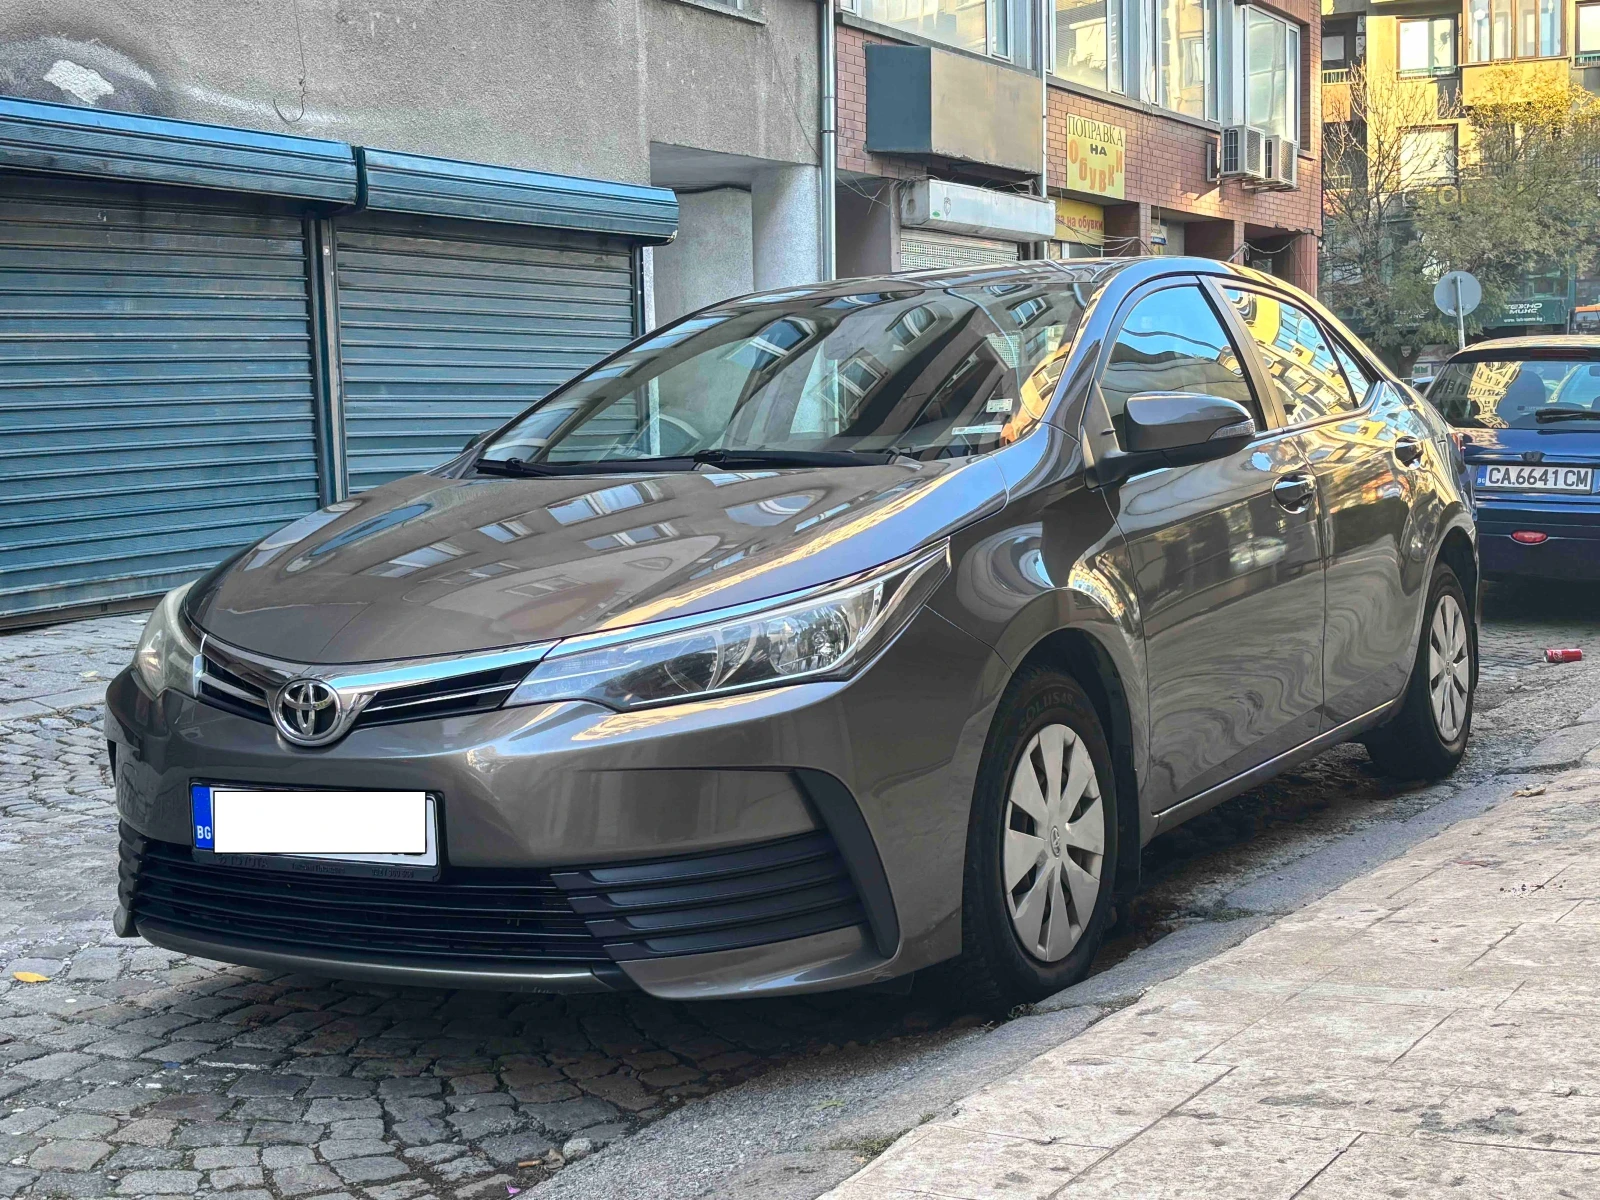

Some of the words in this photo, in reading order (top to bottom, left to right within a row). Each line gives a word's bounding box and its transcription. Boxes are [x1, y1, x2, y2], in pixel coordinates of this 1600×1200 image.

[1067, 115, 1124, 147] ПОПРАВКА
[1089, 143, 1108, 157] НА
[1066, 215, 1077, 228] на
[1078, 214, 1104, 233] обувки
[196, 825, 212, 840] BG
